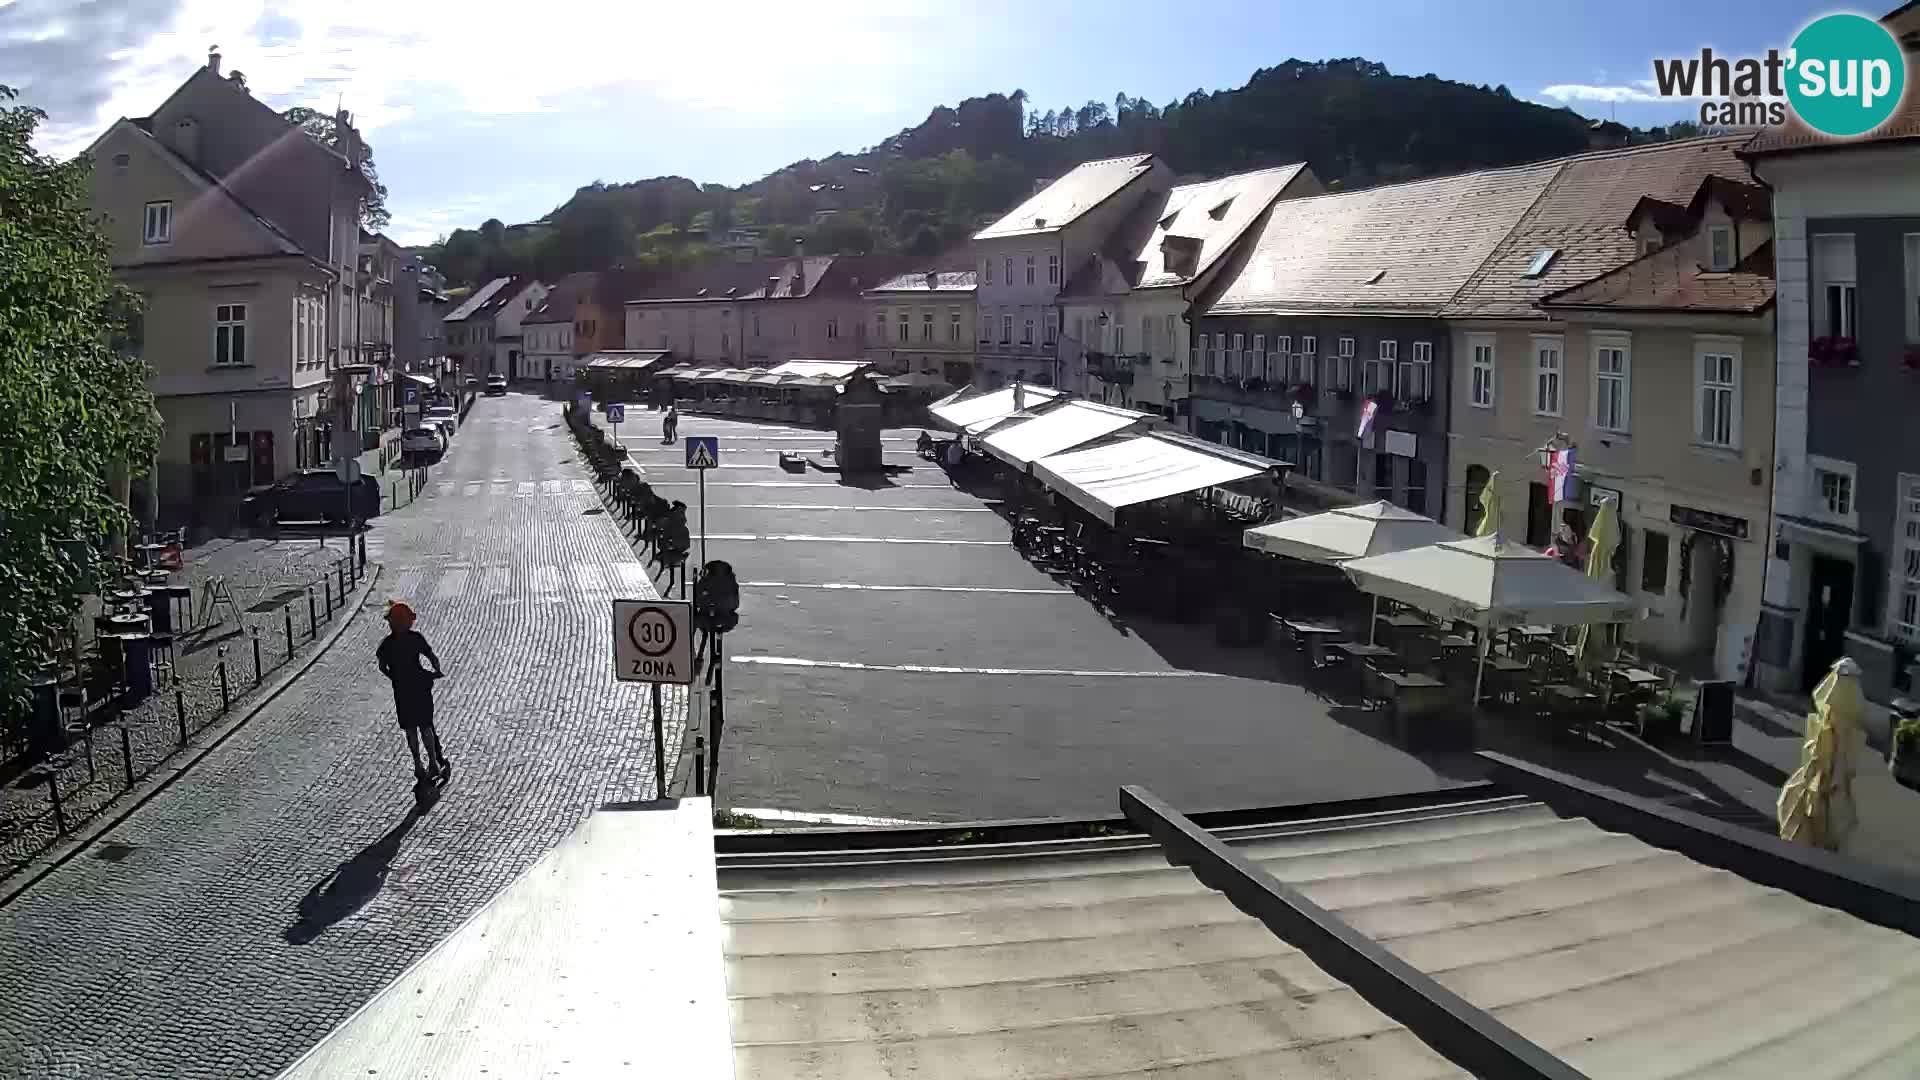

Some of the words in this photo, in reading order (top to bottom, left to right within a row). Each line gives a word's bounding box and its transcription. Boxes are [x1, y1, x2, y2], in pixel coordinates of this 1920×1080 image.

[407, 391, 416, 401] P
[641, 622, 665, 643] 30
[632, 660, 676, 677] ZONA
